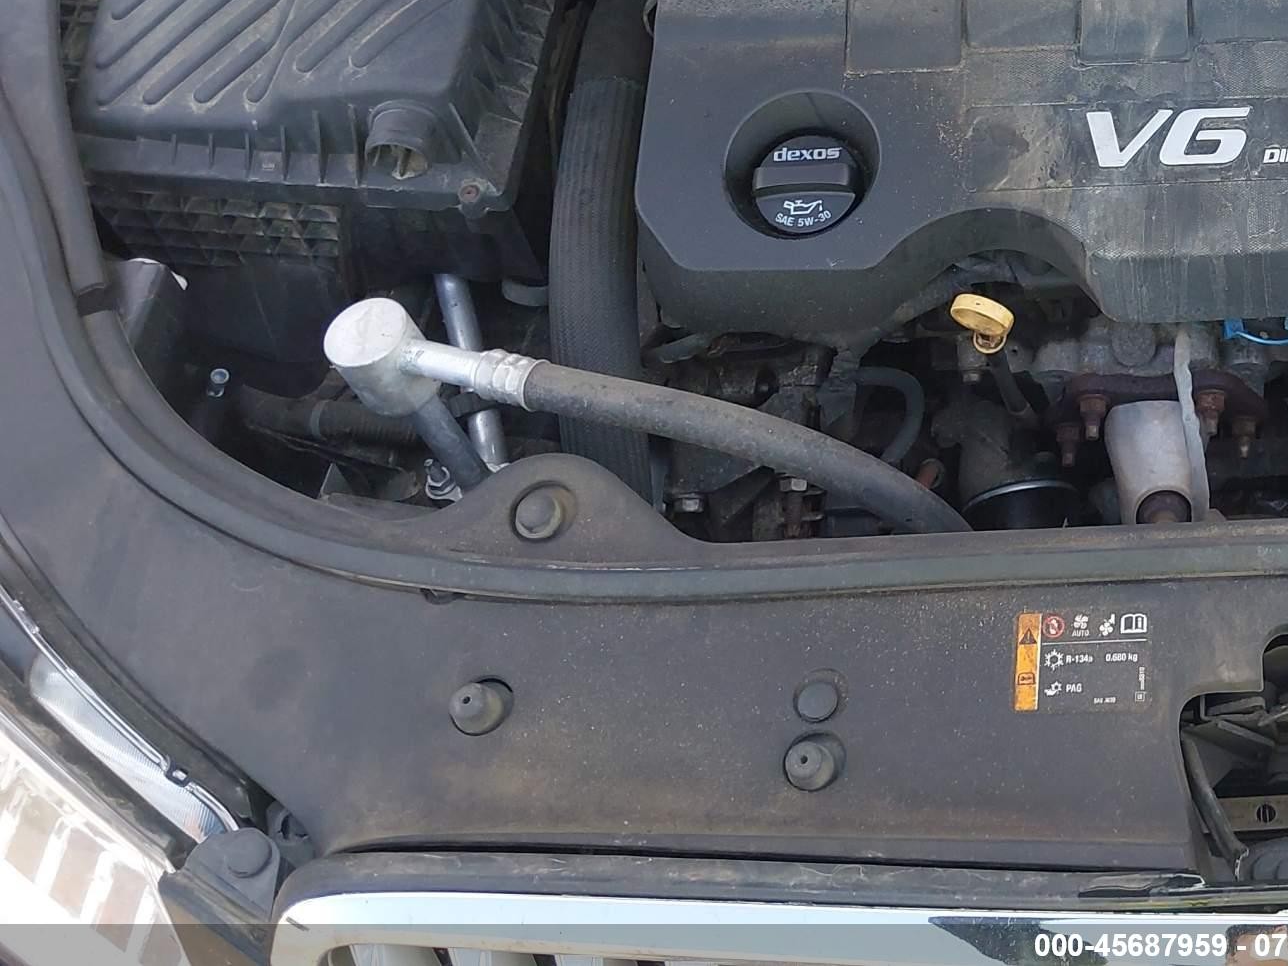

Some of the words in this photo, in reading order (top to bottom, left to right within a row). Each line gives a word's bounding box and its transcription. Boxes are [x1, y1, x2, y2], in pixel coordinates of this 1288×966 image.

[1086, 106, 1251, 168] V6
[773, 147, 842, 162] dexos
[775, 212, 795, 227] SAE
[797, 210, 832, 227] 5W-30
[1071, 629, 1090, 637] AUTO
[1065, 654, 1094, 664] R-134a
[1127, 652, 1139, 663] kg
[1065, 683, 1083, 694] PAG
